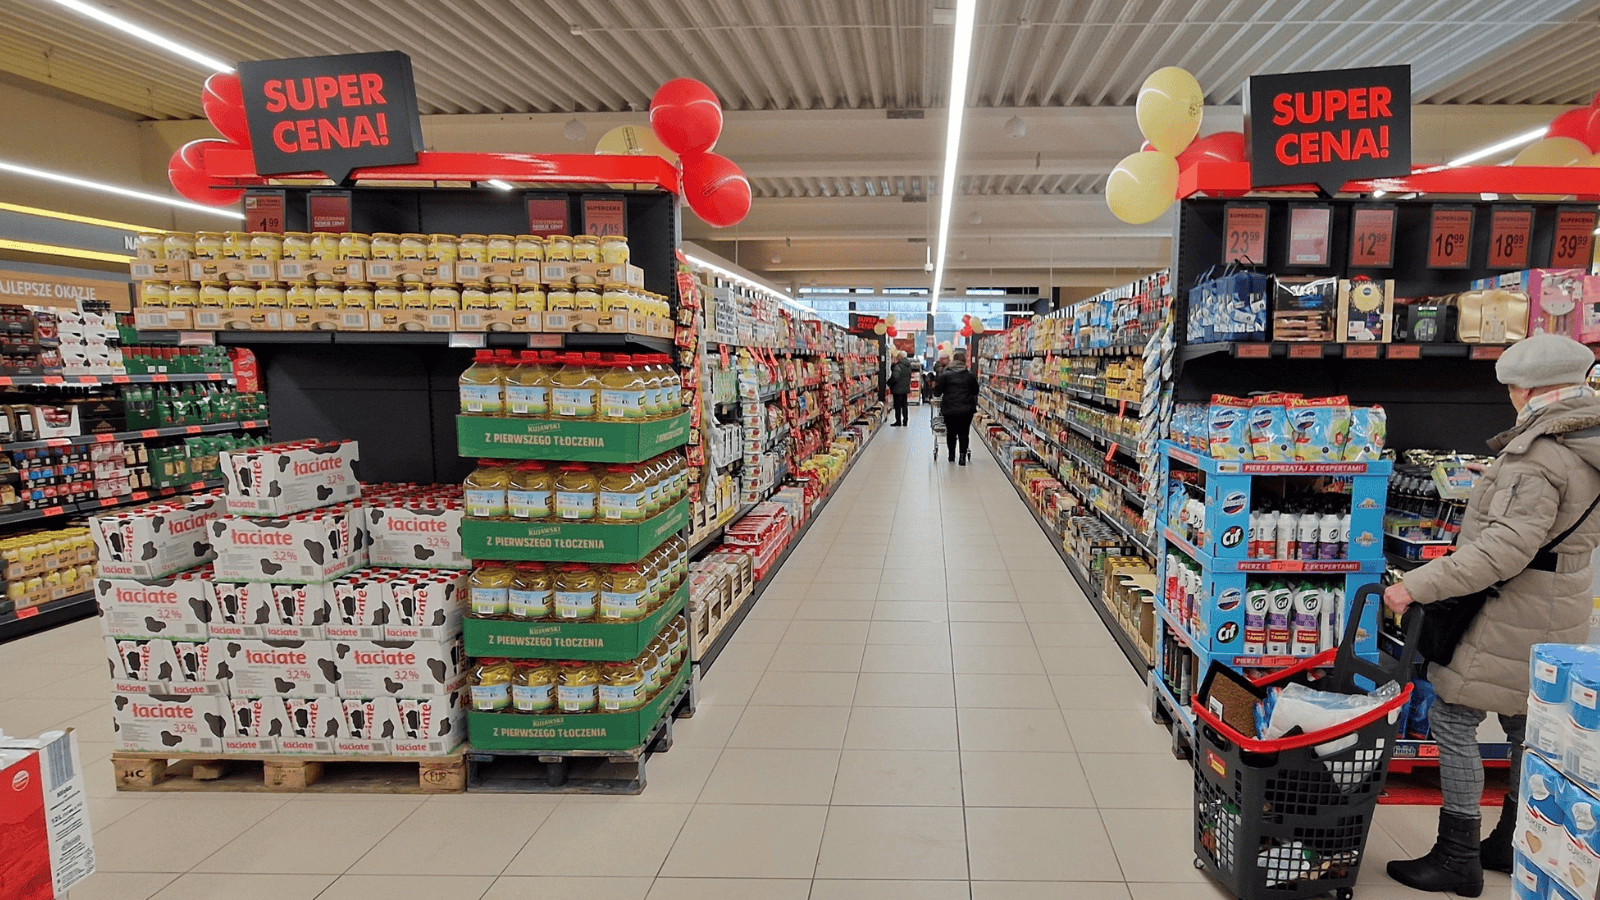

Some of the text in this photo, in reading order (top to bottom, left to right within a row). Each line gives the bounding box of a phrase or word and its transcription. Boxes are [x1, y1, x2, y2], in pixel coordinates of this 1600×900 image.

[263, 72, 386, 113] SUPER
[1272, 86, 1392, 126] SUPER
[273, 112, 390, 152] CENA!
[1276, 126, 1389, 166] CENA!
[0, 280, 96, 300] AJLEPSZE OKAZJE
[485, 433, 604, 447] Z PIERWSZEGO TŁOCZENIA
[387, 517, 447, 532] łaciate
[231, 529, 293, 545] łaciate
[486, 536, 604, 549] Z PIERWSZEGO TŁOCZENIA
[1222, 528, 1242, 546] Cif
[116, 588, 177, 604] łaciate
[1218, 624, 1237, 642] Cif
[488, 636, 604, 647] Z PIERWSZEGO TŁOCZENIA
[246, 650, 307, 664] łaciate
[354, 650, 416, 665] łaciate
[133, 703, 194, 718] łaciate
[493, 728, 606, 738] Z PIERWSZEGO TŁOCZENIA
[430, 771, 446, 782] EUR
